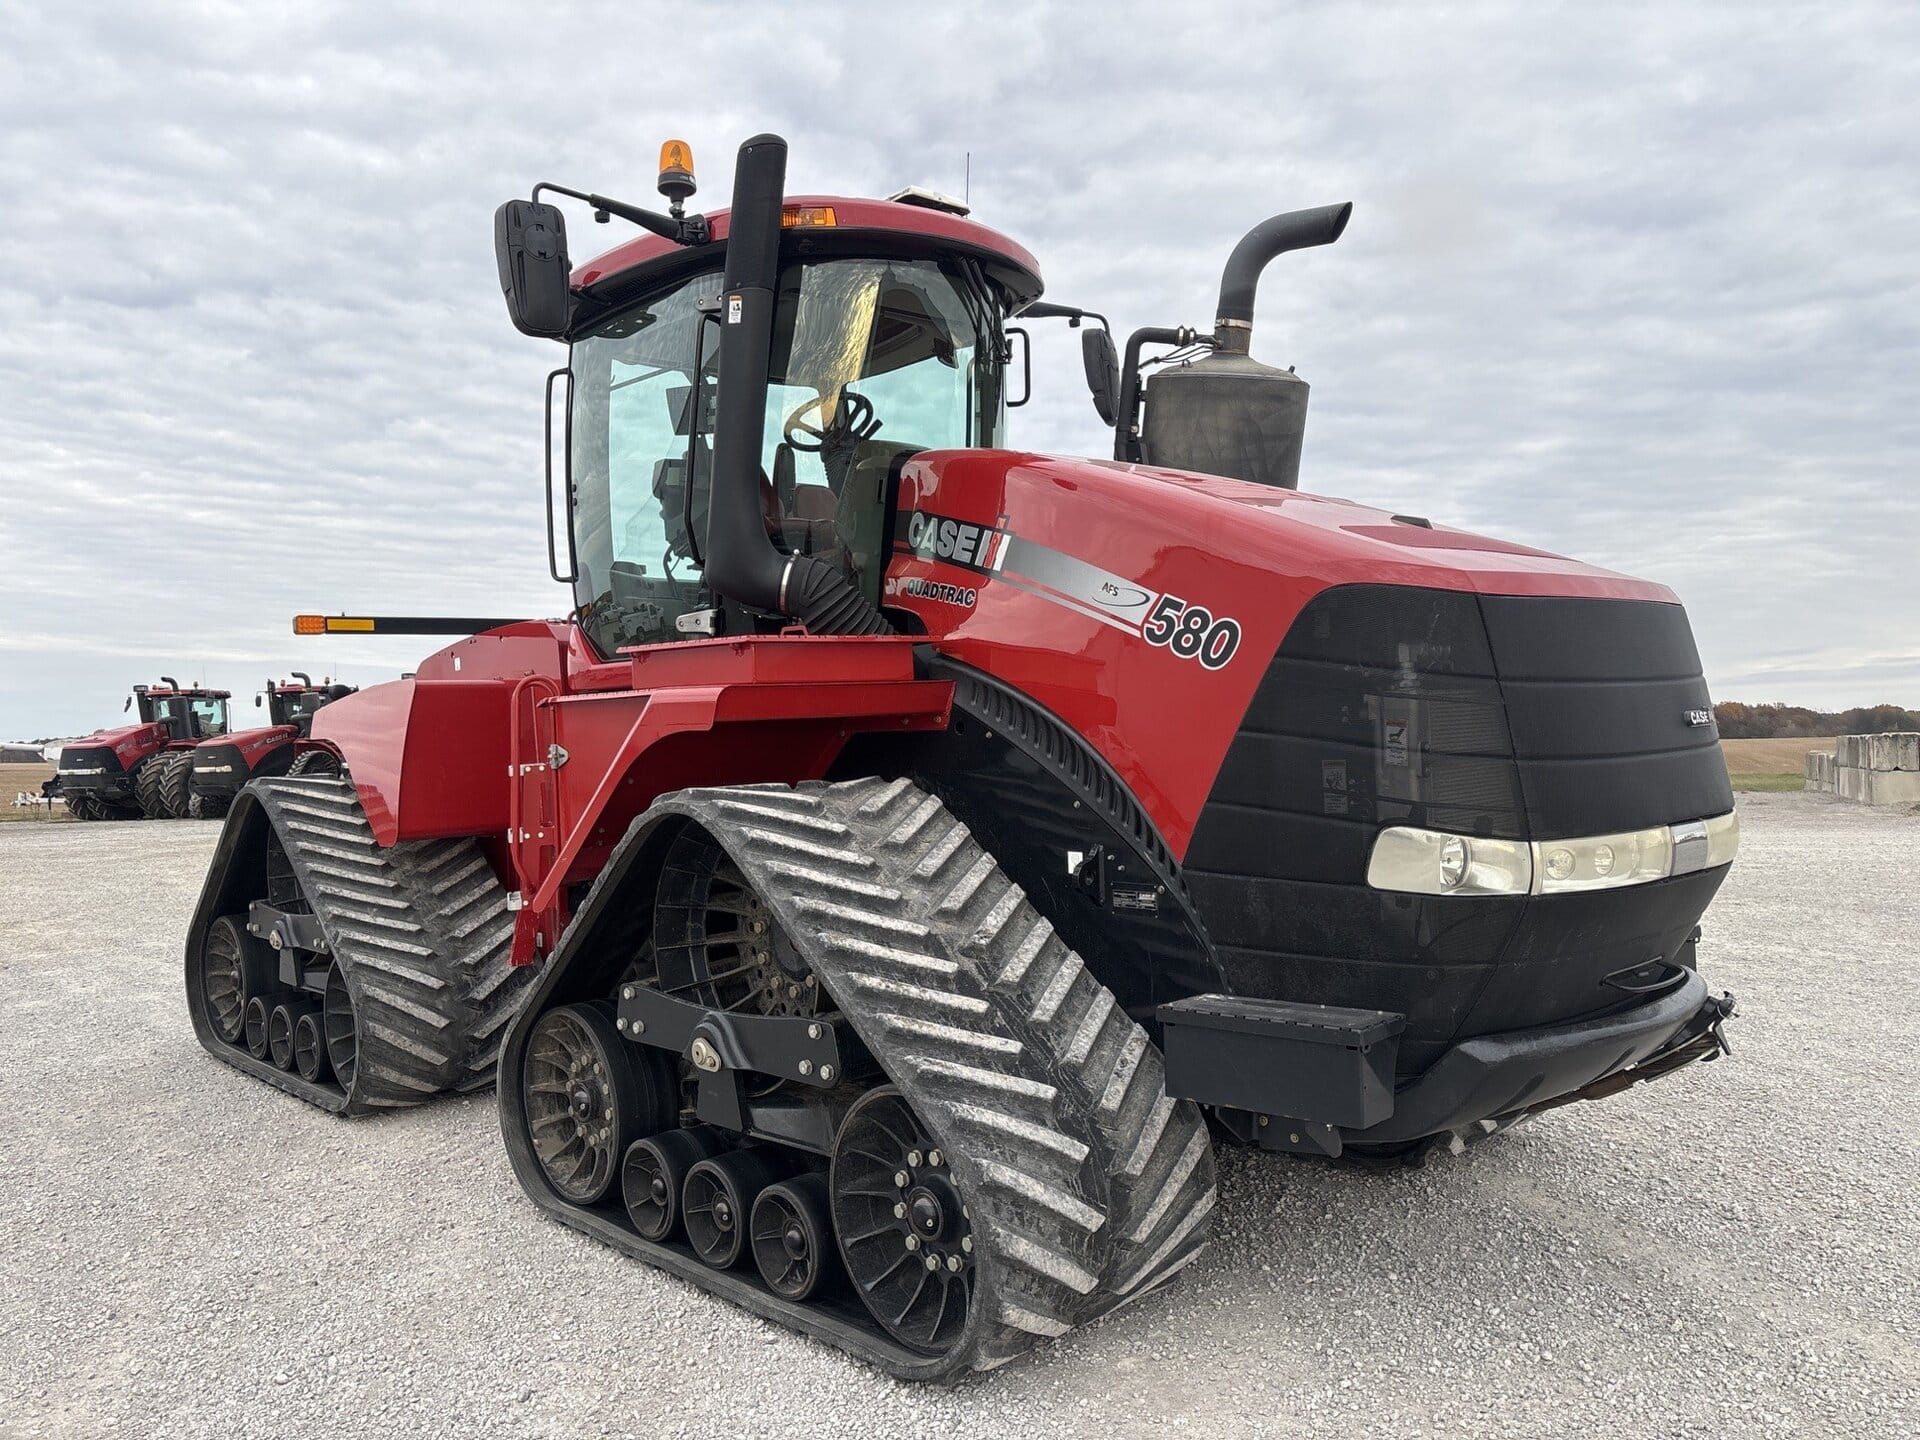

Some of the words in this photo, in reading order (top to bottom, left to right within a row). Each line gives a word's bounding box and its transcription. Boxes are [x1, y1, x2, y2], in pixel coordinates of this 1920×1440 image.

[908, 511, 979, 563] CASE
[907, 579, 976, 608] QUADTRAC
[1102, 582, 1119, 597] AFS
[1144, 593, 1241, 670] 580
[1690, 711, 1709, 724] CASE
